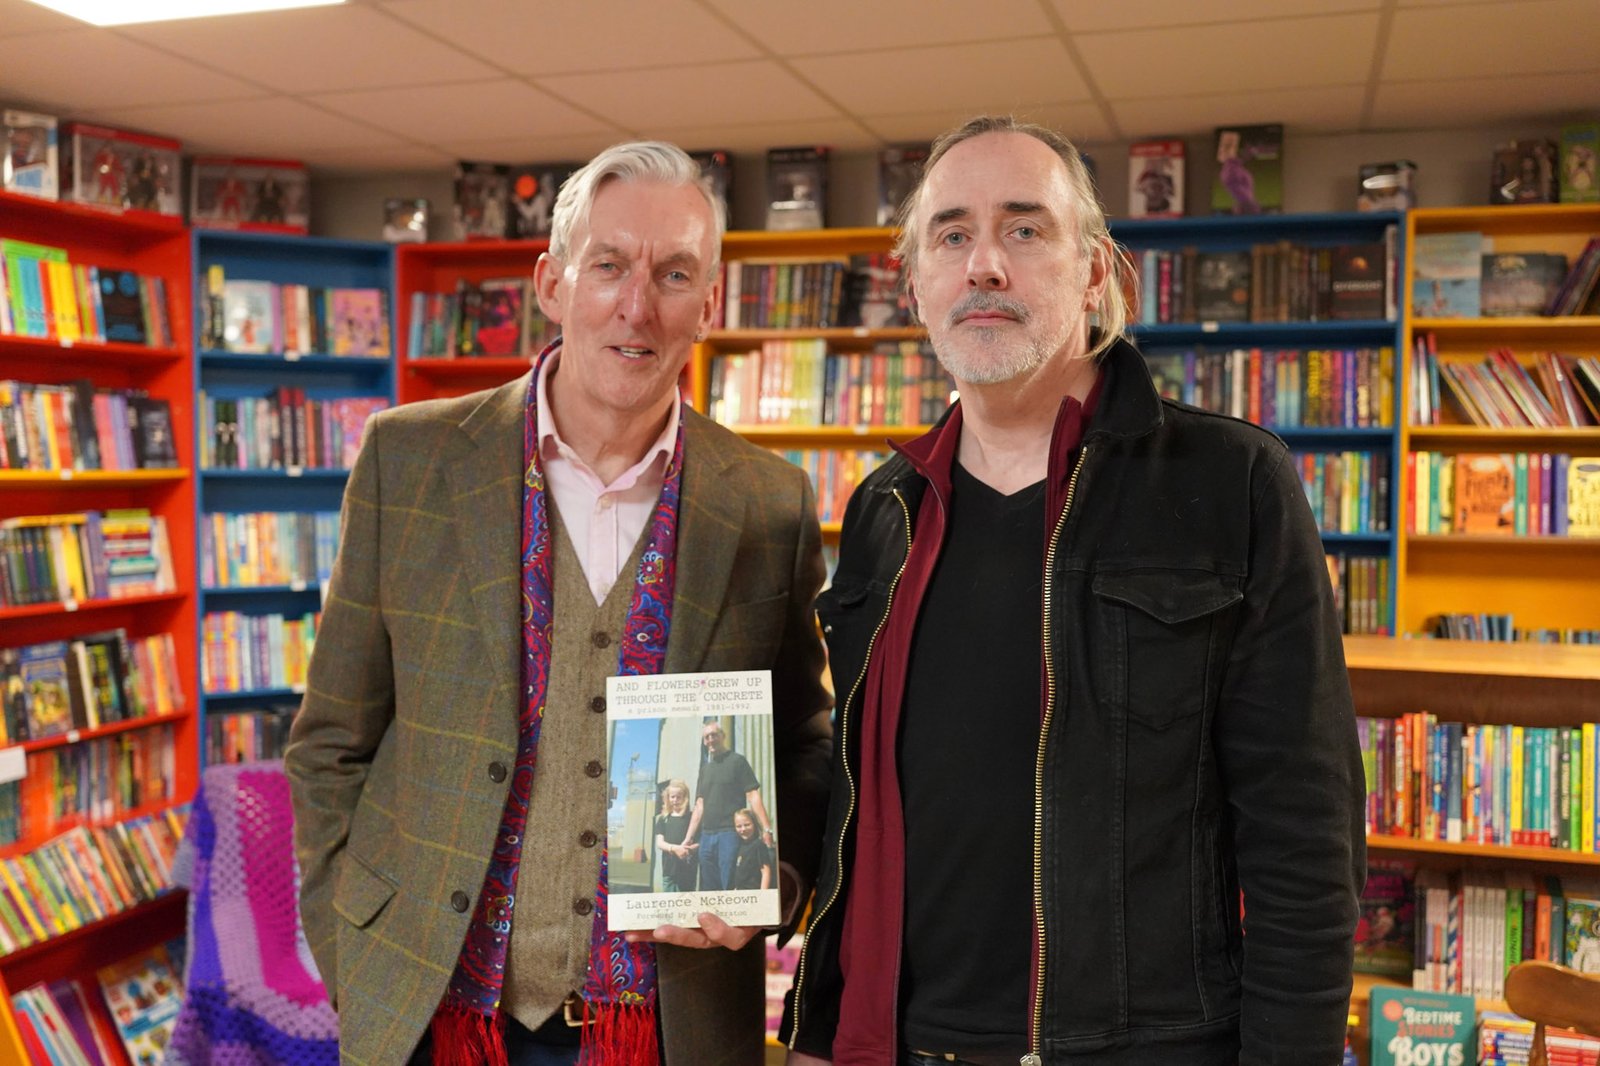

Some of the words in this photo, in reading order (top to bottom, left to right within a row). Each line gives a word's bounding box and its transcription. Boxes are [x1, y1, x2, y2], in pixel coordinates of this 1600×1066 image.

[616, 682, 640, 692] AND
[647, 679, 701, 690] FLOWERS
[707, 677, 739, 688] GREW
[746, 676, 762, 687] UP
[615, 694, 667, 705] THROUGH
[674, 692, 697, 703] THE
[703, 690, 763, 702] CONCRETE
[626, 898, 692, 910] Laurence
[700, 895, 758, 906] McKeown
[1387, 1035, 1465, 1066] BOYS
